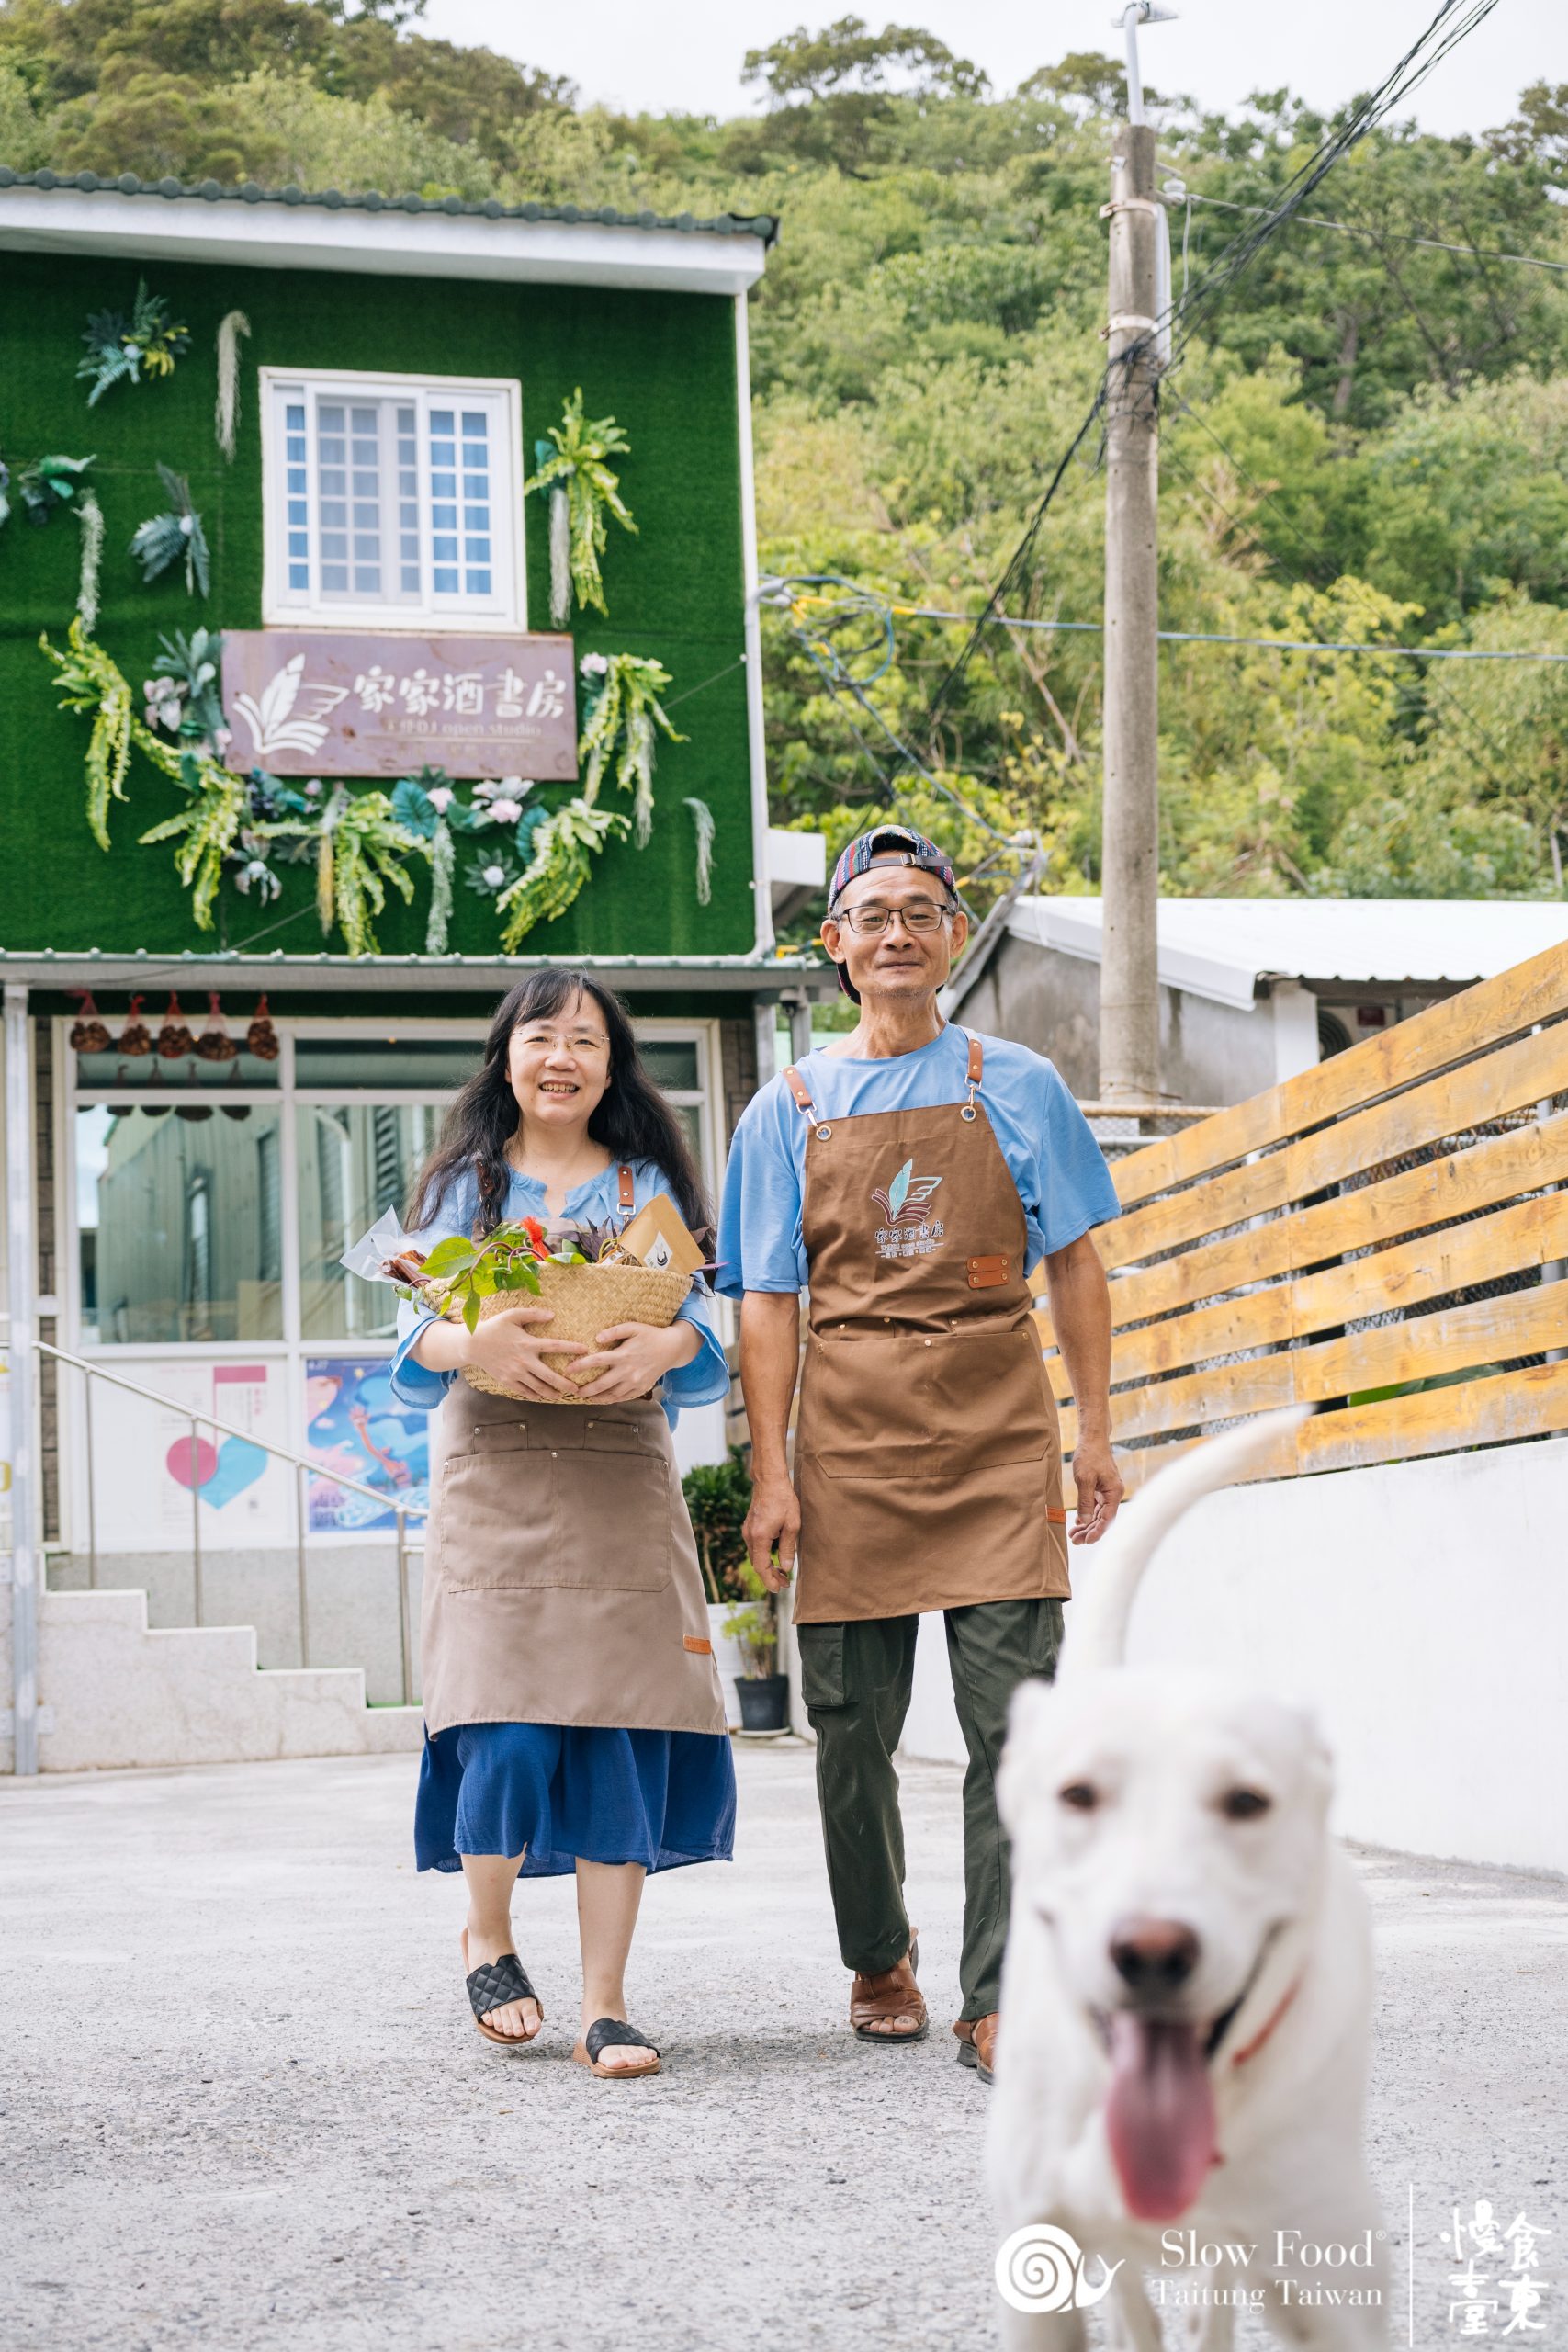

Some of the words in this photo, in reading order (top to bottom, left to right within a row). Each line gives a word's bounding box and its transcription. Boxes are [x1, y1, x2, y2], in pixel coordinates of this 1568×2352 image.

[353, 664, 567, 719] 家家酒書房
[875, 1220, 944, 1243] 家家酒書房
